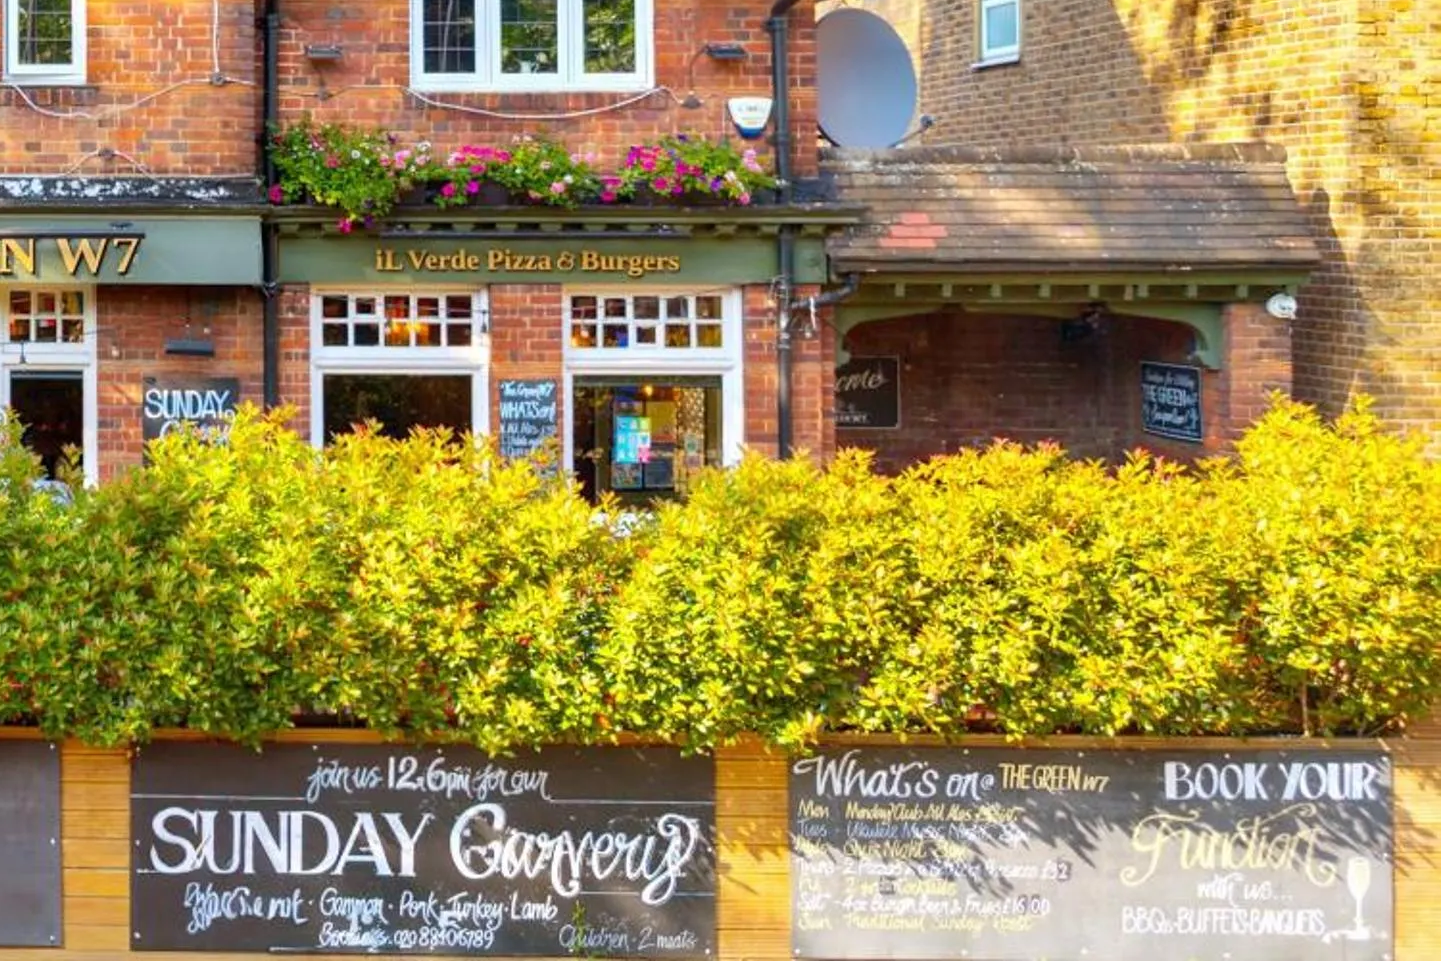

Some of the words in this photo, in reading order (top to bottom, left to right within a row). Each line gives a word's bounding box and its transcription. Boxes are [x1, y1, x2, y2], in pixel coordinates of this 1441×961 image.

[56, 237, 142, 276] W7
[408, 248, 480, 271] Verde
[486, 248, 553, 271] Pizza
[556, 251, 574, 271] &
[580, 248, 681, 277] Burgers
[144, 387, 231, 419] SUNDAY
[792, 749, 940, 798] What's
[946, 773, 982, 802] on
[997, 762, 1032, 790] THE
[1033, 763, 1082, 794] GREEN
[1163, 760, 1270, 801] BOOK
[1278, 761, 1380, 801] YOUR
[798, 799, 830, 818] Mon
[150, 806, 435, 877] SUNDAY
[1120, 803, 1338, 887] Function
[510, 890, 558, 921] Lamb
[1197, 872, 1244, 907] with
